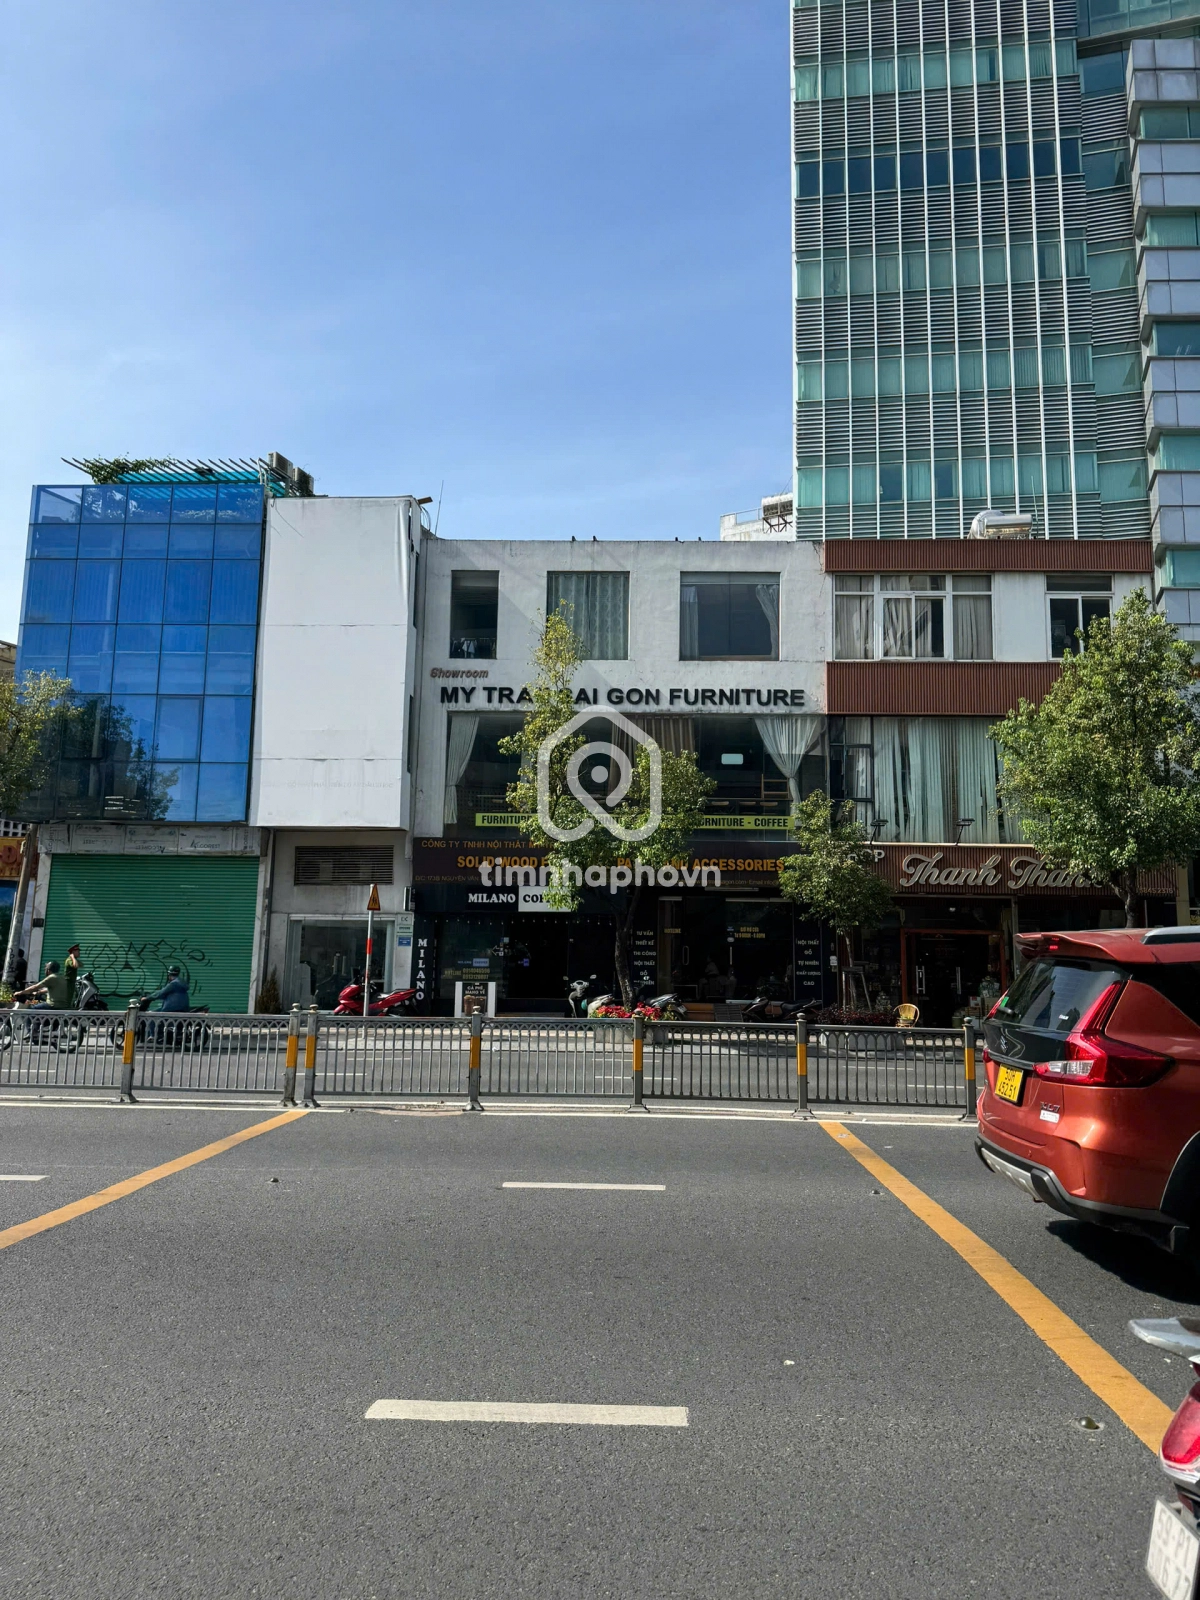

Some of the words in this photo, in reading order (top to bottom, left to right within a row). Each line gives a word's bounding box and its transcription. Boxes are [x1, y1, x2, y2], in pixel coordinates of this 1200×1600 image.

[430, 668, 488, 678] Showroom
[440, 687, 476, 704] MY
[607, 688, 660, 705] GON
[669, 688, 805, 706] FURNITURE
[700, 818, 745, 827] URNITURE
[754, 818, 789, 827] COFFEE
[422, 840, 446, 848] CÔNG
[463, 841, 485, 849] TNHH
[487, 841, 502, 850] NỘI
[457, 855, 495, 868] SOLID
[501, 856, 538, 869] WOOD
[692, 858, 785, 871] ACCESSORIES
[900, 852, 1002, 887] Thanh
[468, 894, 515, 903] MILANO
[415, 938, 428, 1000] MILANO
